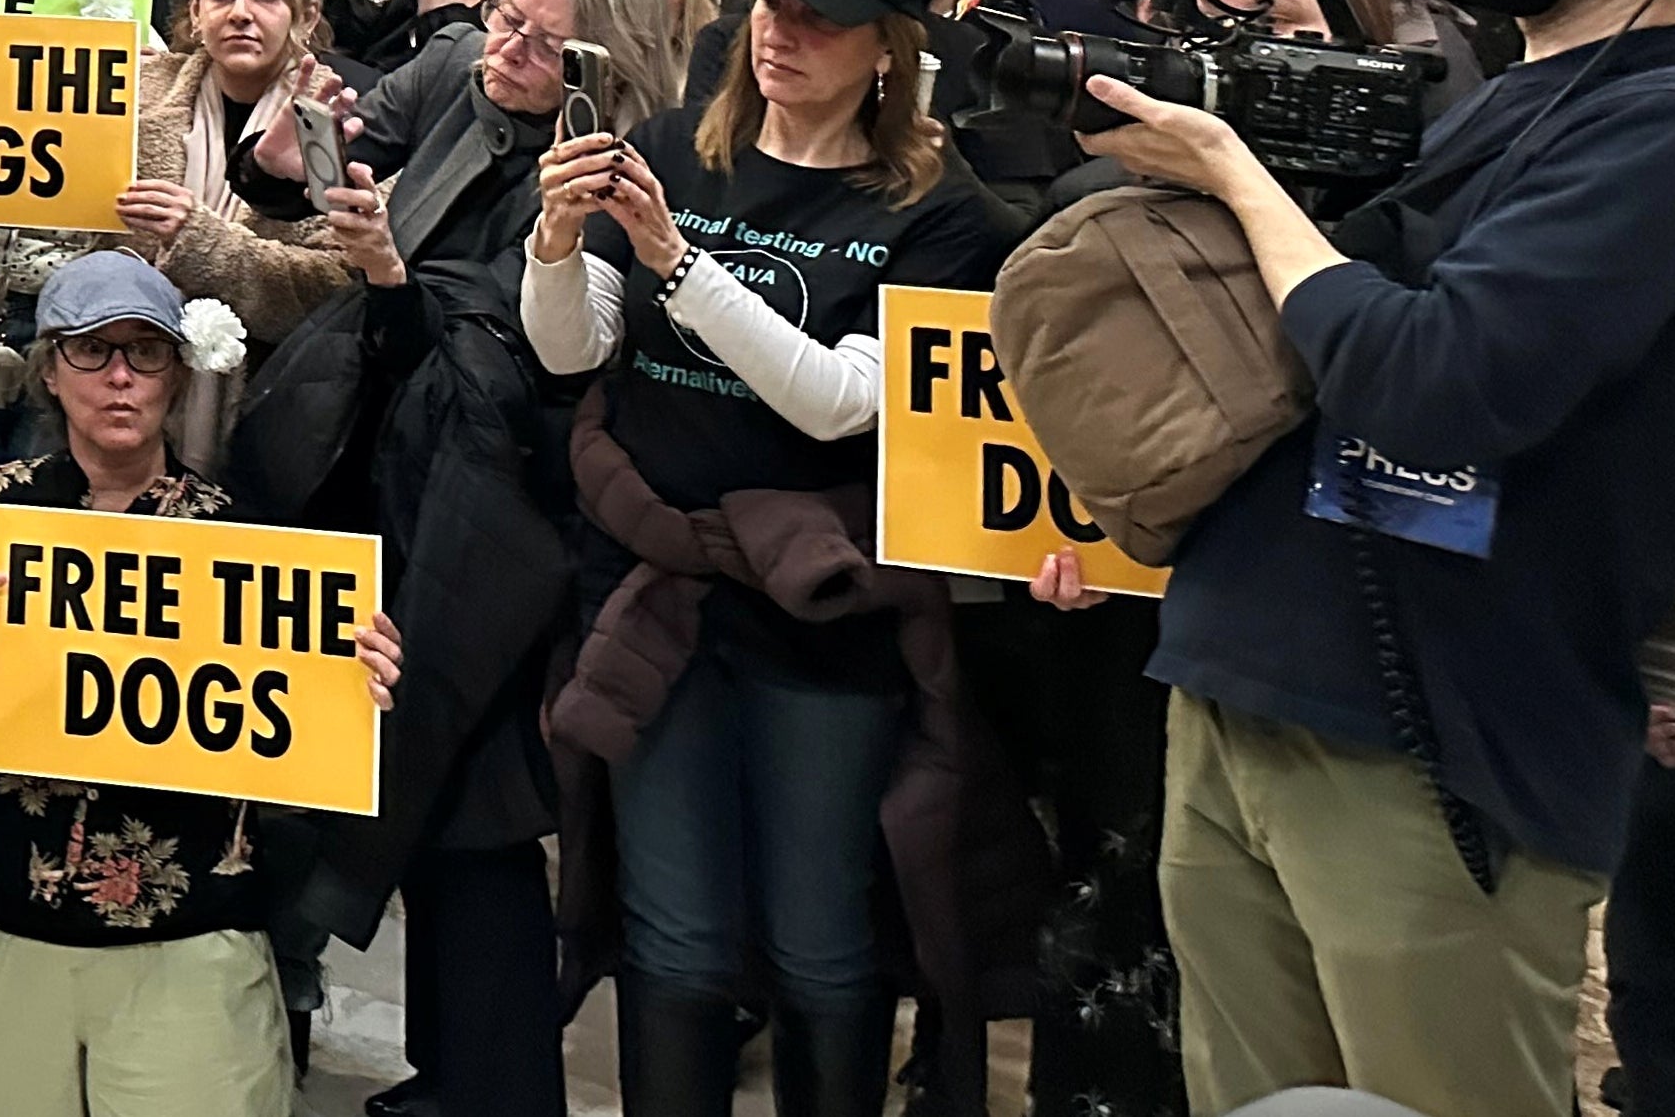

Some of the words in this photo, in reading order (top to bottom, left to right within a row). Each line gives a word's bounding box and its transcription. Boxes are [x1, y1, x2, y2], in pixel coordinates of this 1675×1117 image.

[9, 44, 128, 116] THE
[1356, 58, 1407, 72] SONY
[734, 221, 826, 259] testing
[845, 241, 890, 268] NO
[7, 542, 182, 640] FREE
[212, 560, 357, 658] THE
[64, 651, 293, 759] DOGS
